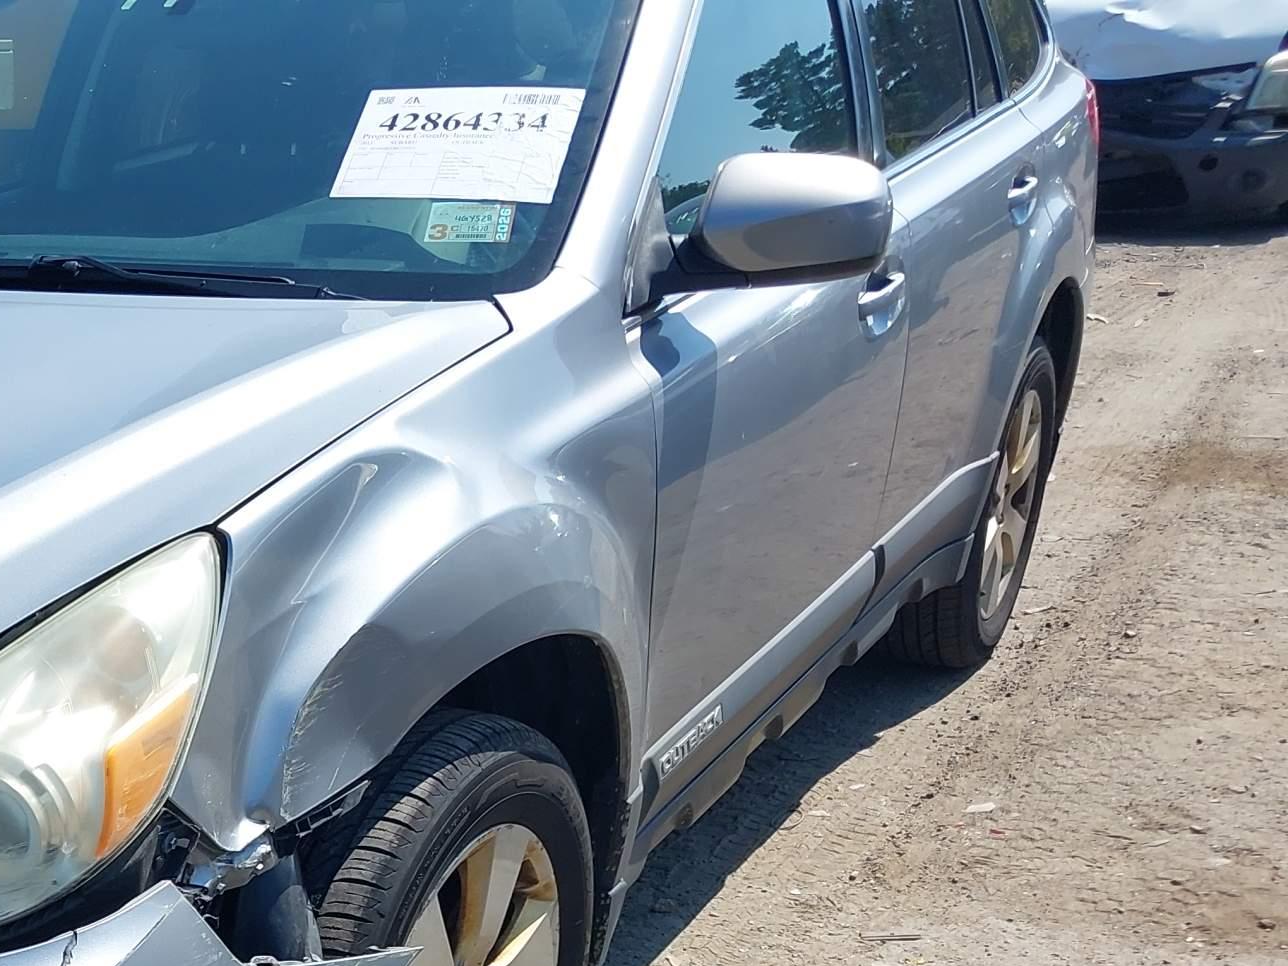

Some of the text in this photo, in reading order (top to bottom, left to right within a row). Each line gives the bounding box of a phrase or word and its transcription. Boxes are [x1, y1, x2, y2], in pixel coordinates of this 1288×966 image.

[379, 111, 549, 132] 42864334
[428, 223, 449, 241] 3
[496, 208, 511, 240] 2026
